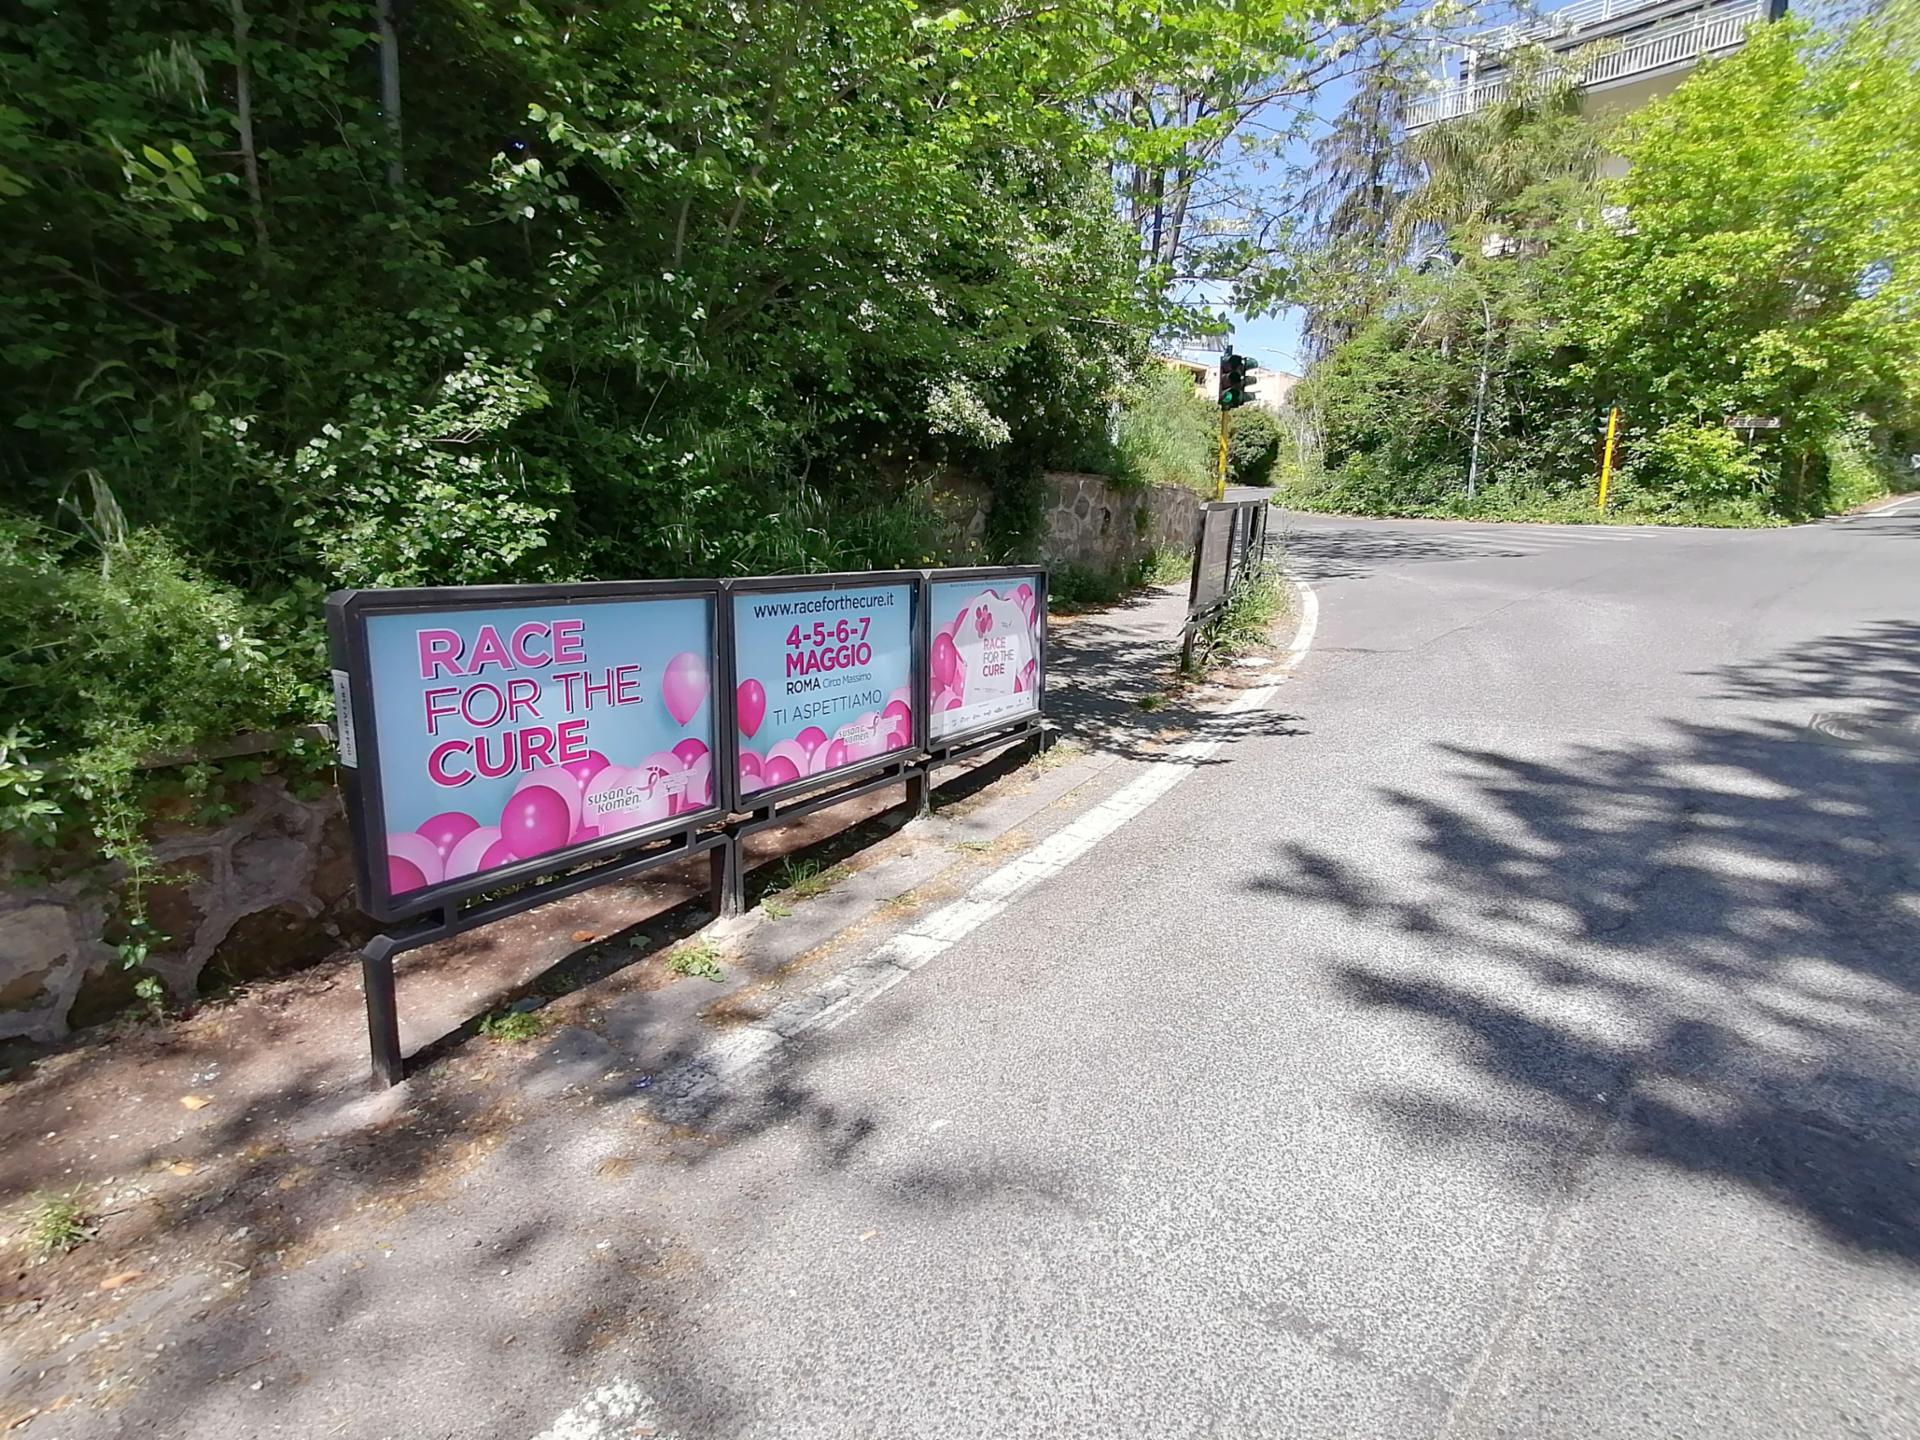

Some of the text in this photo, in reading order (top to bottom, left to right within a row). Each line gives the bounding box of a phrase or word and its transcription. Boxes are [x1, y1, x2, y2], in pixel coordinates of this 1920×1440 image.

[754, 592, 894, 618] www.raceforthecure.it
[786, 617, 870, 649] 4-5-6-7
[984, 637, 1006, 650] RACE
[417, 619, 585, 679] RACE
[786, 642, 872, 678] MAGGIO
[983, 649, 1015, 664] FOR THE
[786, 678, 821, 695] ROMA
[842, 672, 872, 685] Massimo
[983, 663, 1005, 677] CURE
[424, 664, 642, 734] FOR THE
[773, 689, 882, 726] TI ASPETTIAMO
[427, 719, 591, 788] CURE
[588, 788, 624, 806] susan
